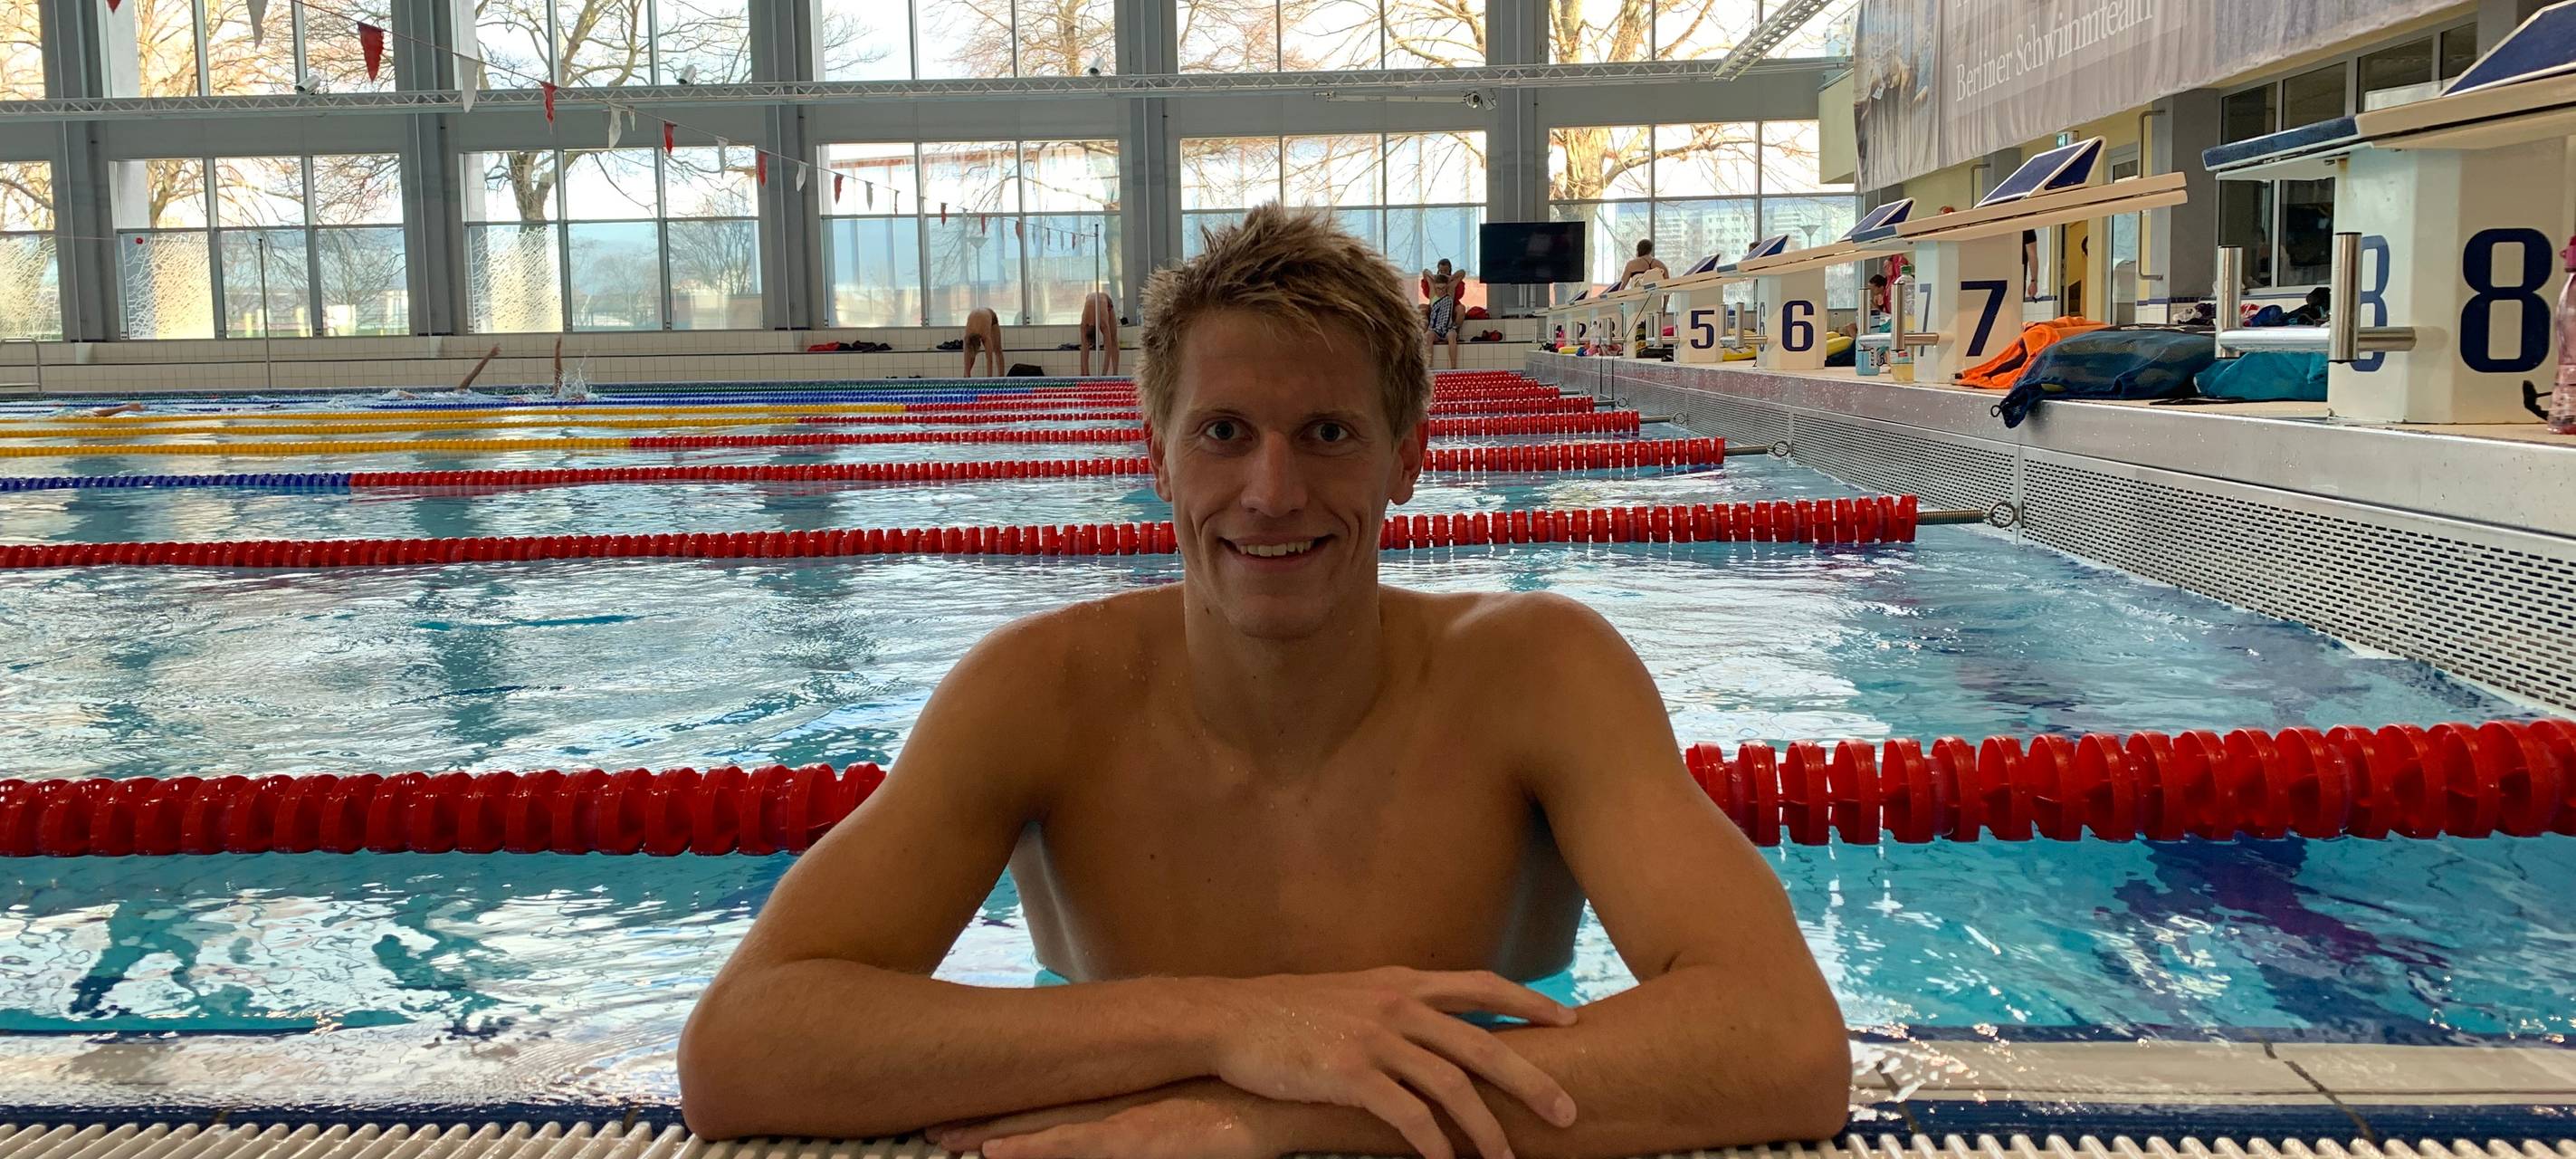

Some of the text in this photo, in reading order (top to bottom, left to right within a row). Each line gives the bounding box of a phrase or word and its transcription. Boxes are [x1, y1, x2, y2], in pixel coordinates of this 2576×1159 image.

[1956, 48, 2013, 101] Berliner
[1690, 310, 1715, 349] 5
[1782, 300, 1814, 351] 6
[1920, 283, 1932, 357] 7
[1961, 280, 2008, 357] 7
[2460, 228, 2552, 373] 8
